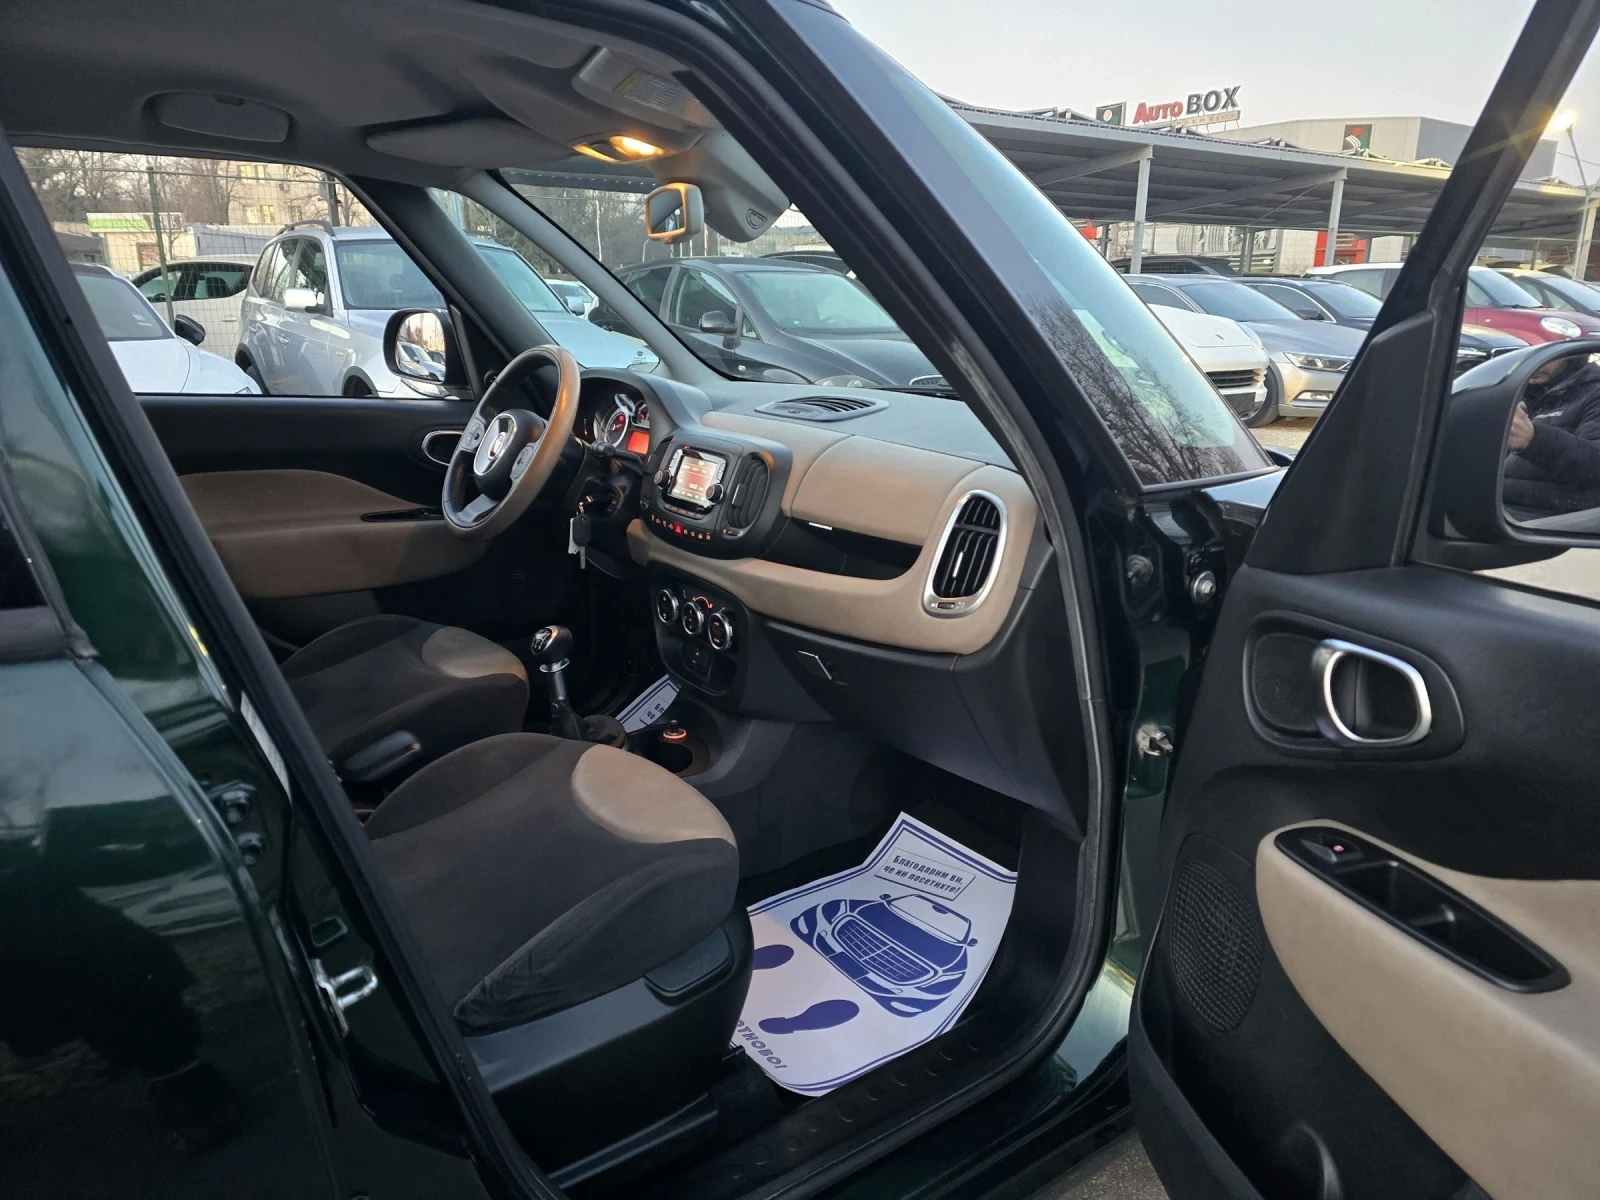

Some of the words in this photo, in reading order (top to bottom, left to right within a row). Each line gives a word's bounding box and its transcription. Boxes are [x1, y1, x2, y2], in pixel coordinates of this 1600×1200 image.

[1186, 85, 1241, 115] BOX
[883, 865, 895, 874] че
[895, 868, 907, 877] ни
[908, 872, 961, 894] посетихте!
[893, 855, 949, 880] Благодарим
[949, 874, 963, 885] ви,
